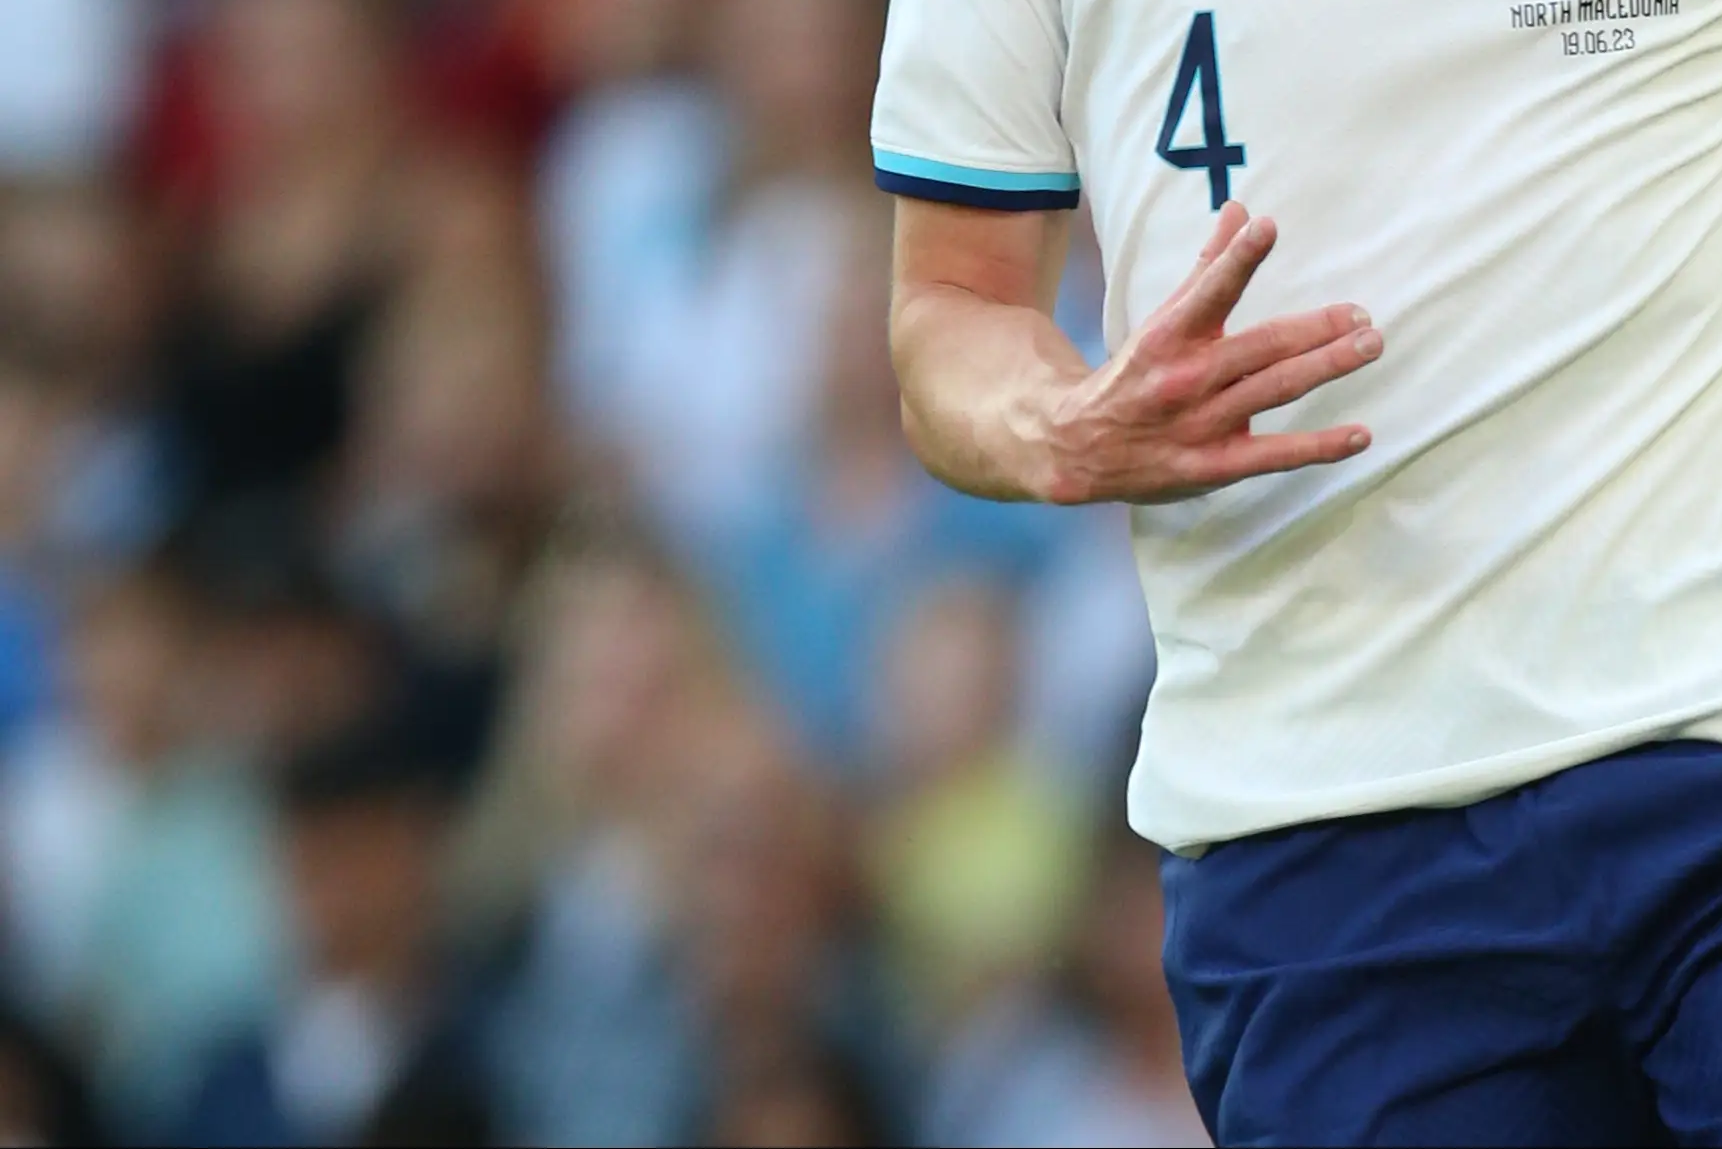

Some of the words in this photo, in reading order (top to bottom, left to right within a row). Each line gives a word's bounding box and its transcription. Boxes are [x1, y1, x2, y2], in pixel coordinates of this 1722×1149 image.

[1510, 0, 1571, 28] NORTH
[1561, 28, 1636, 56] 19.06.23
[1155, 9, 1247, 213] 4
